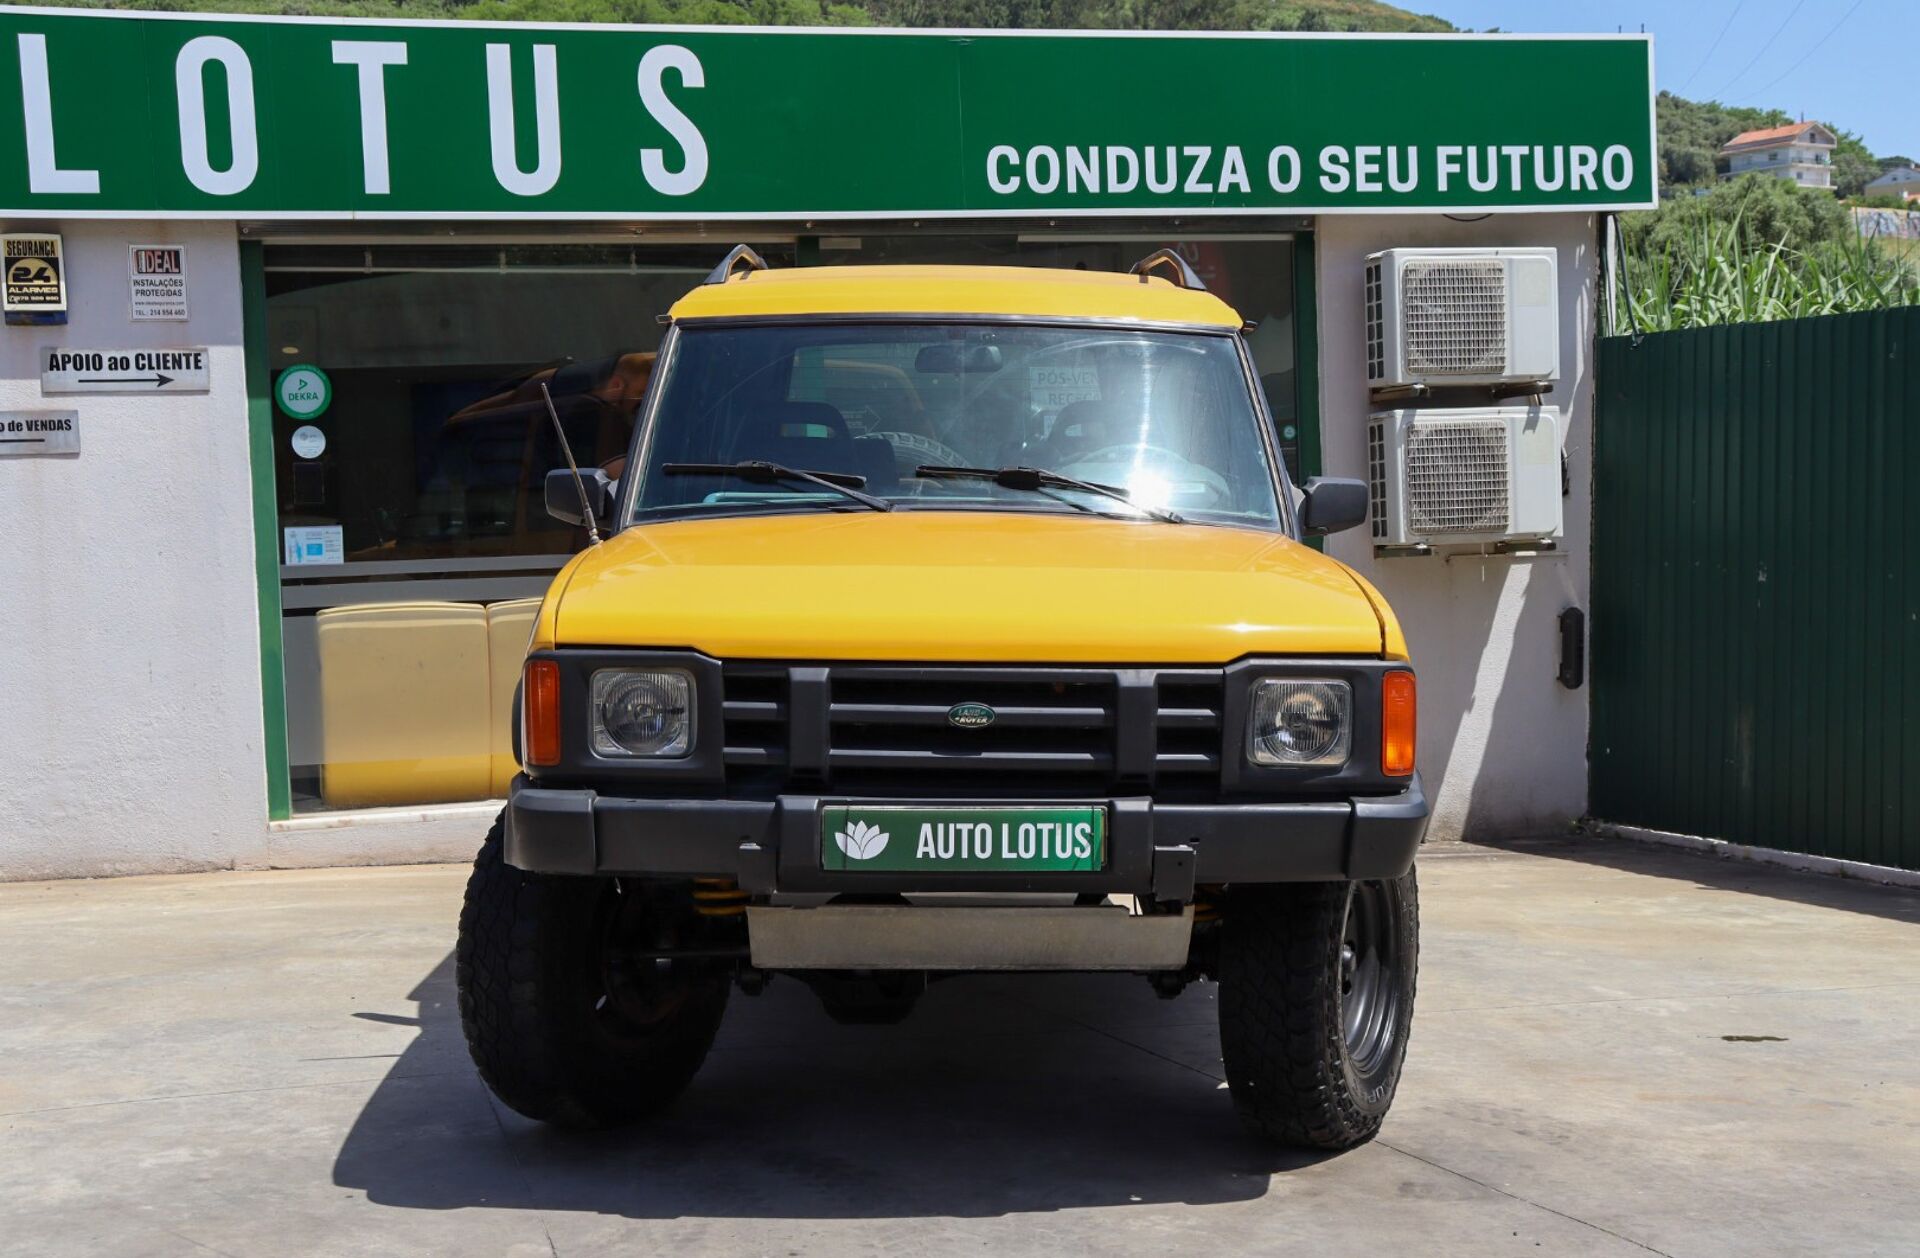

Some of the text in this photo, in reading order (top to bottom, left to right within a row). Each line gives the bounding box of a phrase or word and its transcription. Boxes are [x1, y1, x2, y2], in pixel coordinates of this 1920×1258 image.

[18, 33, 709, 197] LOTUS
[986, 144, 1634, 194] CONDUZA O SEU FUTURO
[137, 251, 180, 274] IDEAL
[13, 266, 50, 285] 24
[133, 277, 184, 289] INSTALAÇÕES
[8, 286, 59, 294] ALARMES
[135, 289, 183, 298] PROTEGIDAS
[50, 352, 203, 372] APOIO ao CLIENTE
[288, 392, 319, 401] DEKRA
[8, 420, 23, 432] de
[25, 418, 72, 432] VENDAS
[916, 823, 1092, 859] AUTO LOTUS
